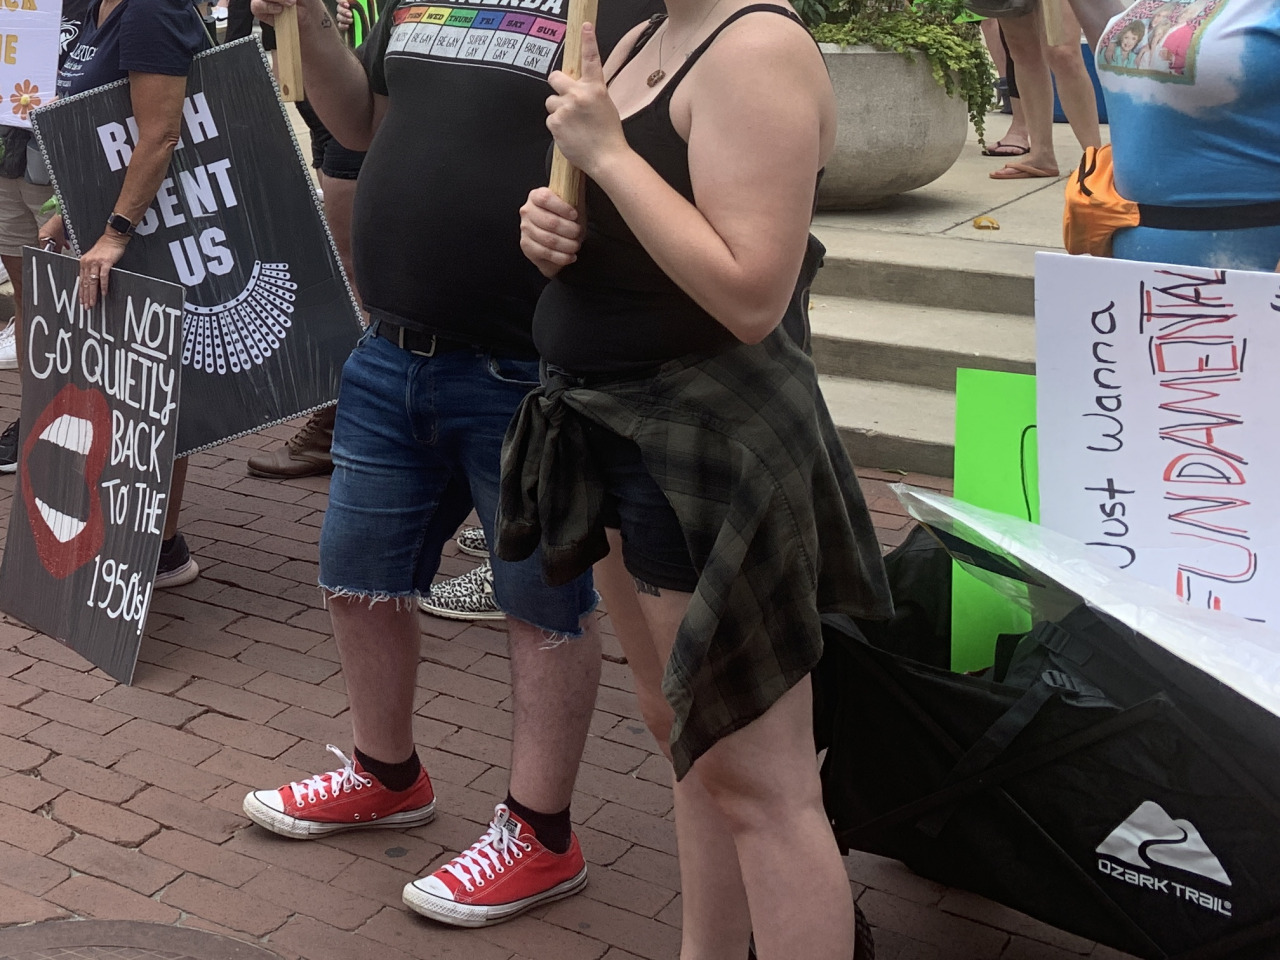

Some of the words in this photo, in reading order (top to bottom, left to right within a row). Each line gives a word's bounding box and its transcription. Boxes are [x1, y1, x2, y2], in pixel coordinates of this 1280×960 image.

[427, 13, 445, 21] WED
[449, 15, 474, 23] THURS
[479, 17, 495, 25] FRI
[506, 20, 525, 28] SAT
[537, 26, 558, 37] SUN
[467, 35, 488, 45] SUPER
[494, 37, 518, 50] SUPER
[465, 47, 480, 57] GAY
[492, 49, 508, 60] GAY
[524, 42, 551, 58] BRUNCH
[524, 56, 541, 68] GAY
[96, 91, 218, 171] RH
[168, 227, 235, 287] US
[31, 256, 38, 306] I
[125, 295, 182, 356] NOT
[28, 315, 73, 380] GO
[81, 339, 177, 425] QUIETLY
[1081, 301, 1125, 453] Wanna
[111, 410, 166, 482] BACK
[101, 480, 129, 525] TO
[135, 482, 166, 534] THE
[1085, 477, 1135, 569] Just
[1098, 859, 1169, 893] OZARK
[1171, 882, 1232, 916] TRAIL
